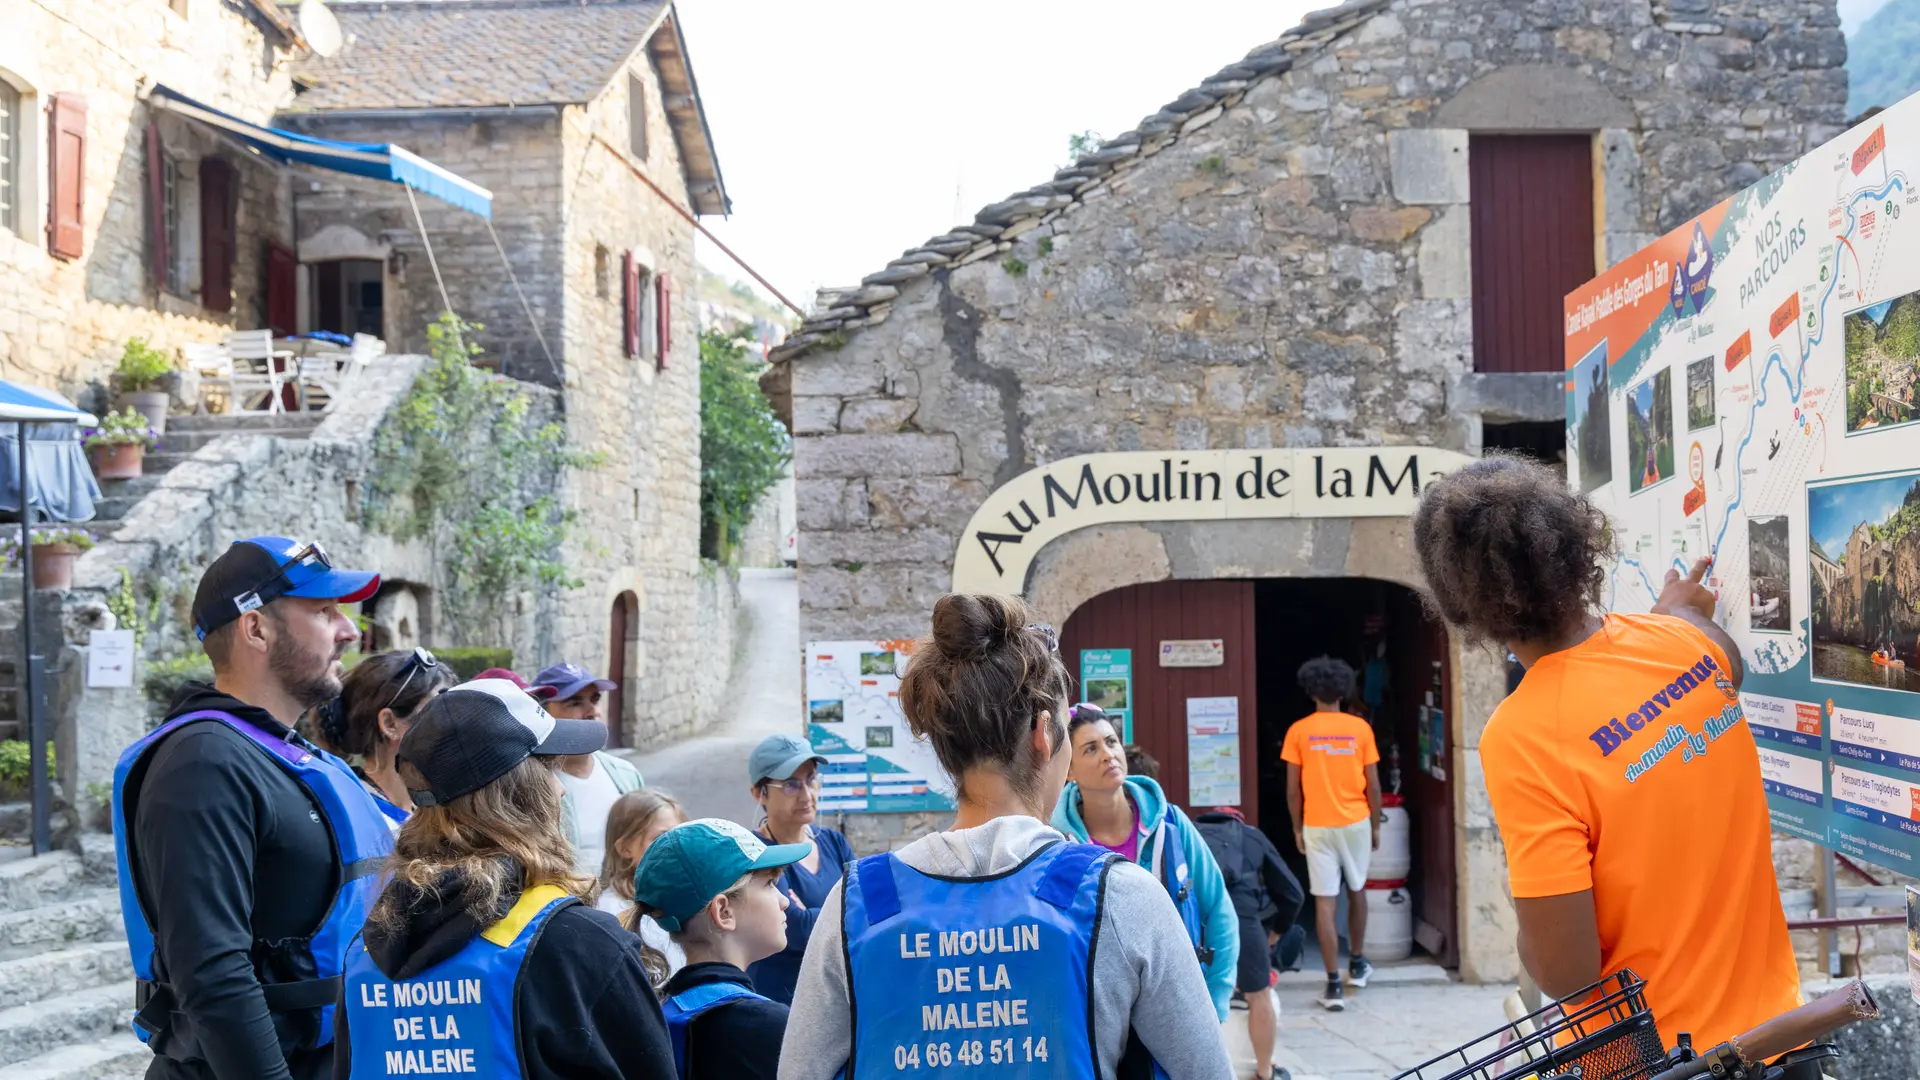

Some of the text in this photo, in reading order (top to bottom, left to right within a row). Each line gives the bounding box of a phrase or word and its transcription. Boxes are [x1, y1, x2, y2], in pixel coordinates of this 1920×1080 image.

[1755, 211, 1782, 259] NOS
[1740, 217, 1806, 309] PARCOURS
[976, 499, 1041, 577] Au
[1043, 459, 1222, 518] Moulin
[1236, 456, 1291, 500] de
[1312, 455, 1355, 498] la
[1589, 654, 1718, 757] Bienvenue
[1703, 704, 1744, 743] Malèn
[1840, 714, 1875, 732] Parcours Lucy
[1625, 724, 1687, 783] Au moulin
[1683, 748, 1693, 763] de
[1687, 732, 1706, 755] La
[1899, 757, 1904, 766] Le
[1912, 759, 1917, 769] de
[1841, 772, 1900, 797] Parcours des Troglodytes
[1900, 821, 1905, 829] Le
[1913, 824, 1917, 833] de
[901, 924, 1039, 958] LE MOULIN
[937, 964, 1011, 993] DE LA
[361, 979, 481, 1008] LE MOULIN
[393, 1014, 460, 1041] DE LA
[922, 999, 1028, 1031] MALENE
[385, 1048, 476, 1075] MALENE
[894, 1036, 1048, 1070] 04 66 48 51 14
